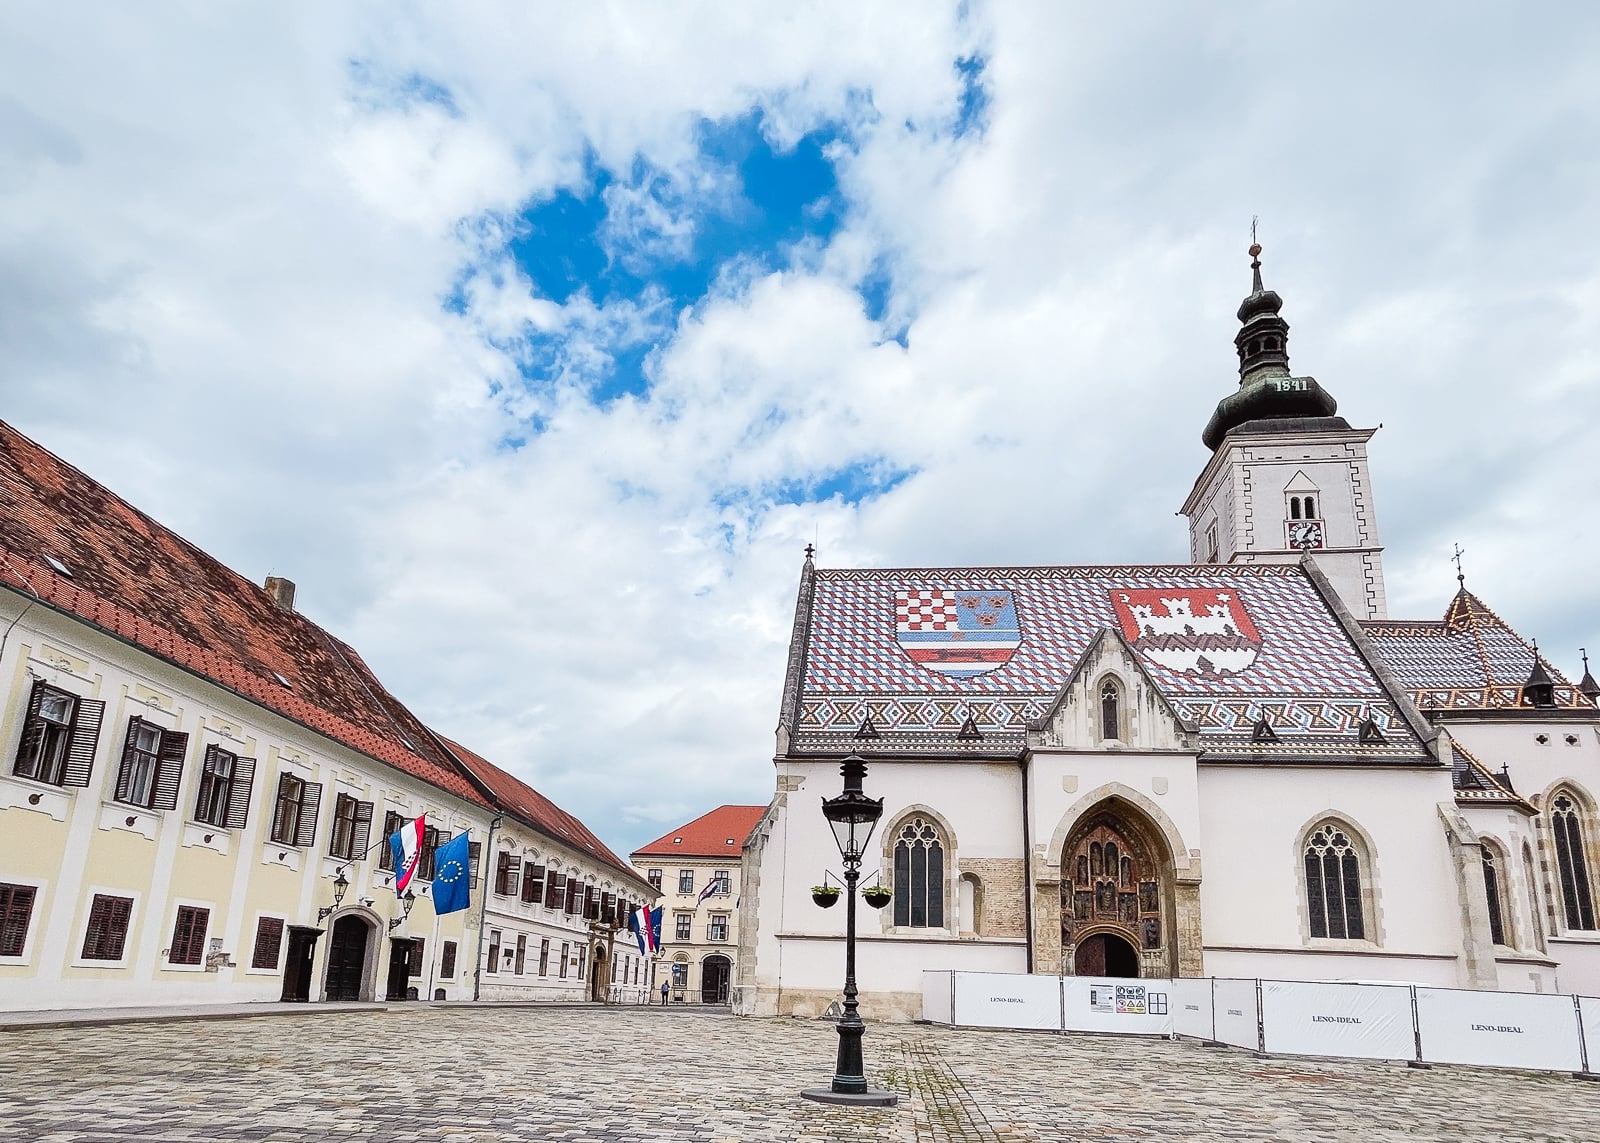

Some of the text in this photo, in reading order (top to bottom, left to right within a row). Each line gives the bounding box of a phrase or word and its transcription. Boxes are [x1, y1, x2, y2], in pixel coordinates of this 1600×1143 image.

[1276, 380, 1307, 391] 1841
[1312, 1015, 1362, 1024] LENO-IDEAL
[1471, 1024, 1524, 1034] LENO-IDEAL
